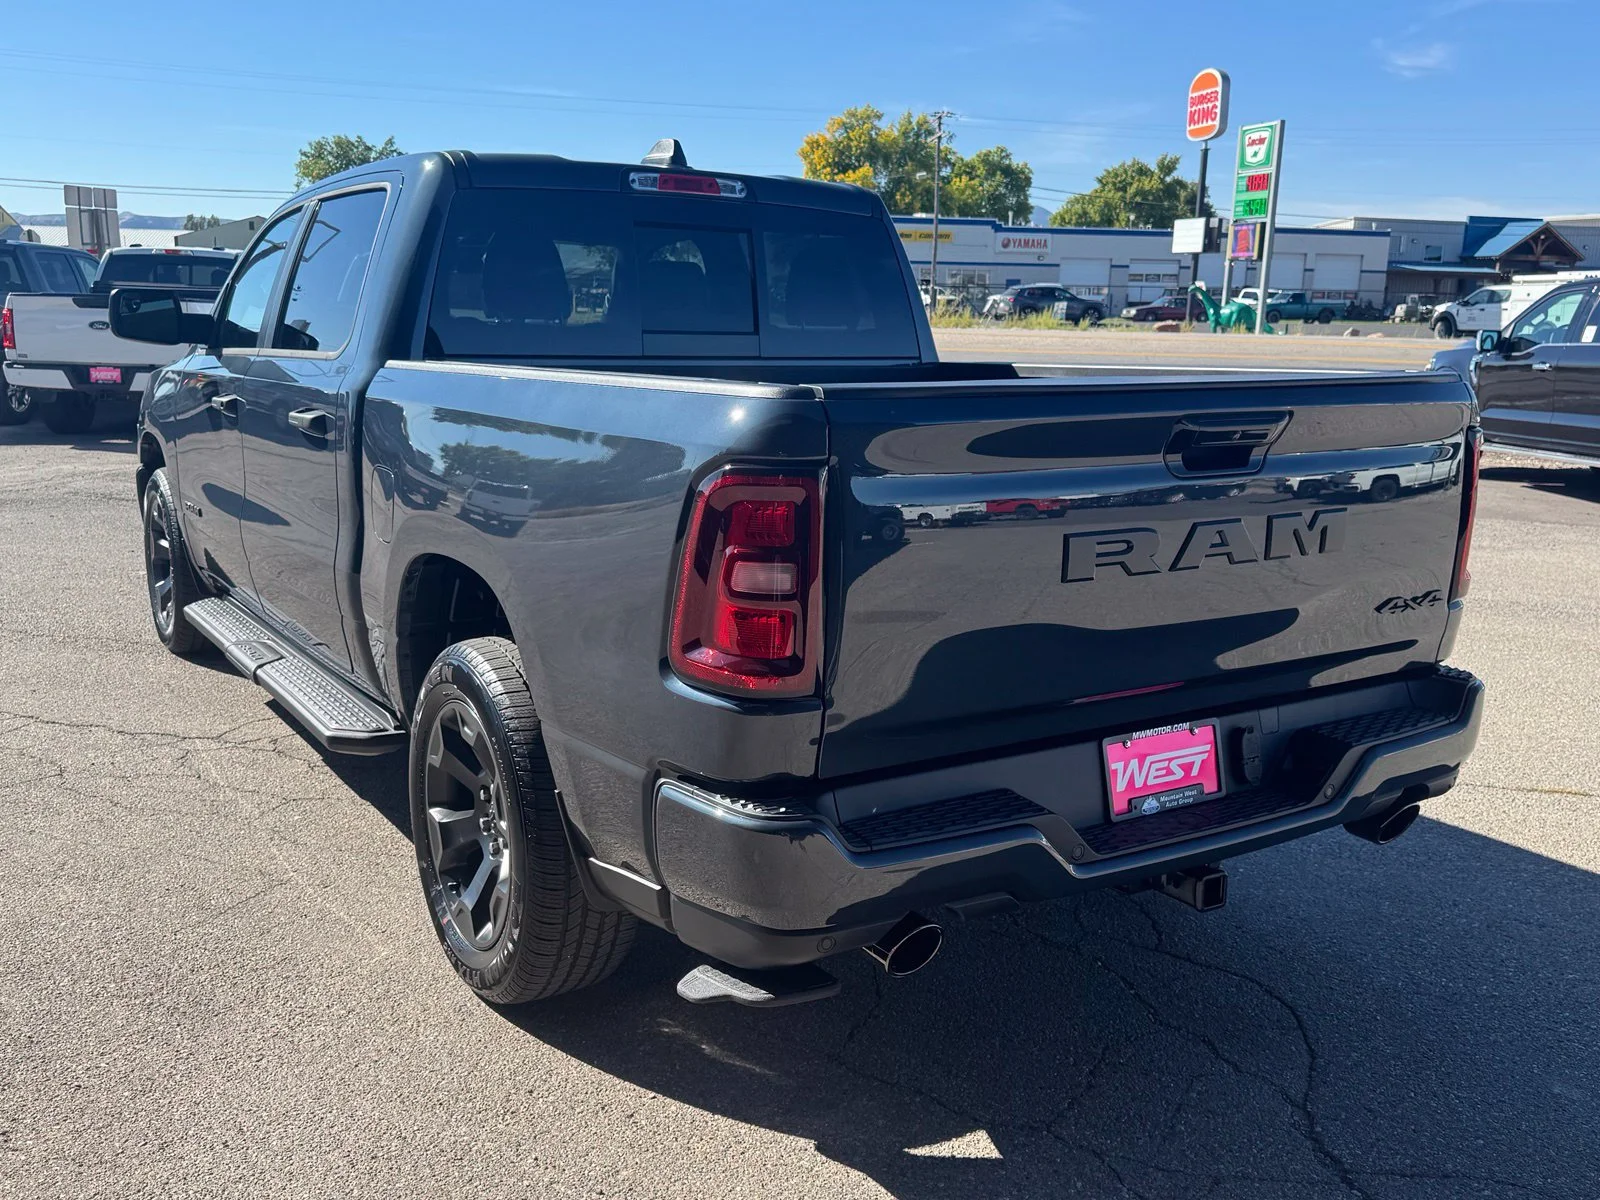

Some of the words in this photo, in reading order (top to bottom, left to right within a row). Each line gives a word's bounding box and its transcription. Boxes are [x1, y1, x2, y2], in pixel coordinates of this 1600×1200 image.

[1189, 90, 1219, 109] BURGER
[1188, 104, 1218, 127] KING
[1012, 237, 1047, 249] YAMAHA
[1061, 507, 1348, 584] RAM
[1132, 722, 1190, 740] MWMOTOR.COM
[1111, 744, 1211, 792] WEST
